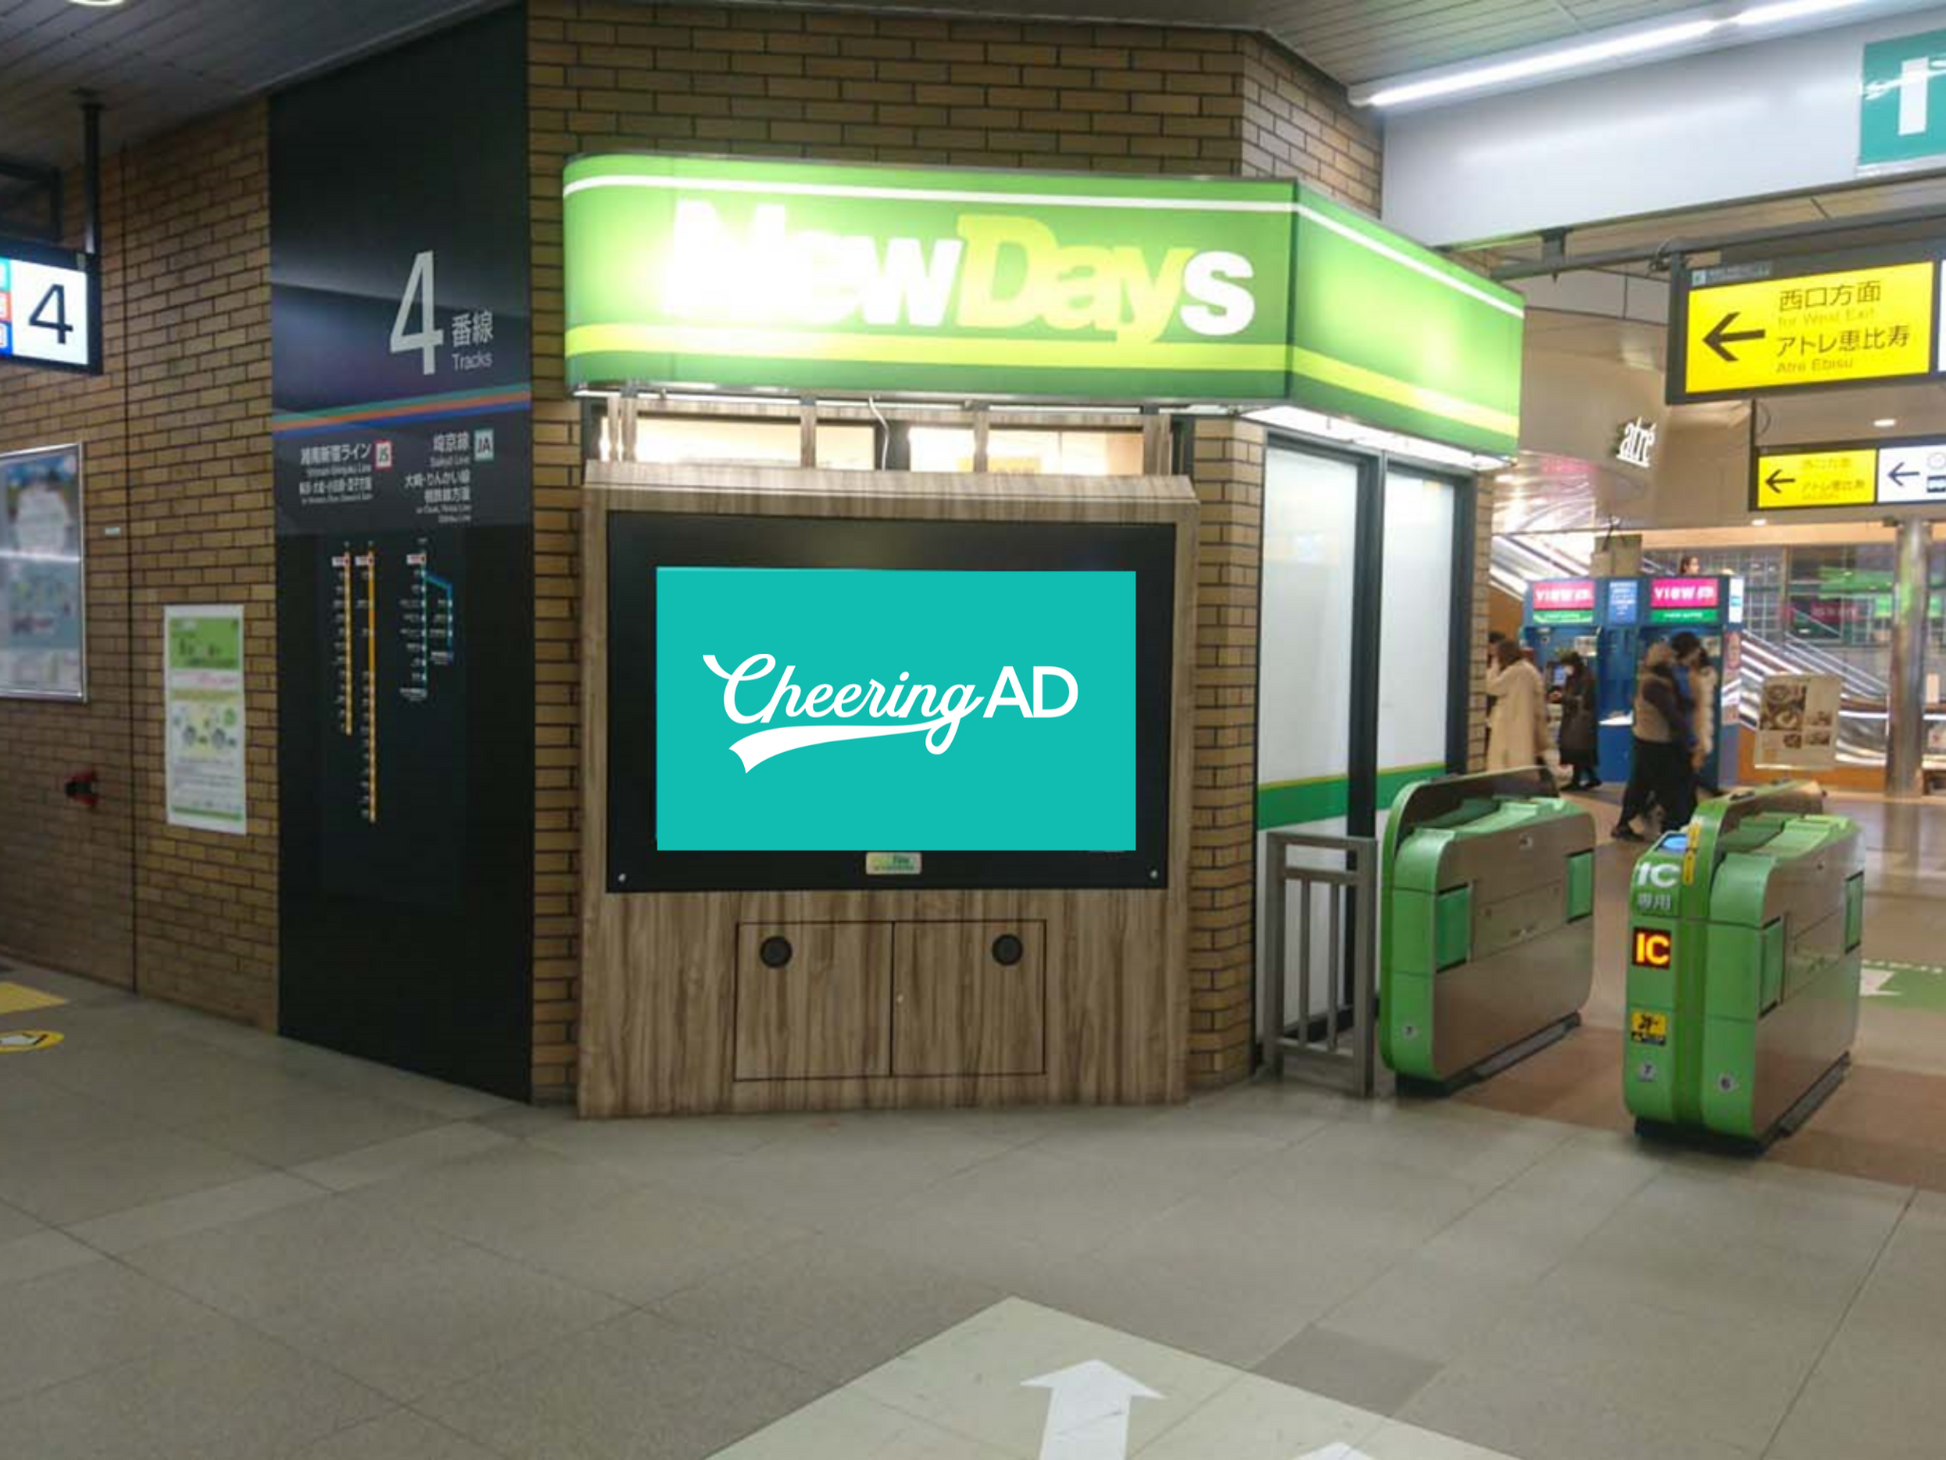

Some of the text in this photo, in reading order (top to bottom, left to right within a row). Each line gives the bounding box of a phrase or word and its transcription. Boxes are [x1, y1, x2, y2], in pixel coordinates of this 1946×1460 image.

[665, 200, 1255, 343] NewDays
[390, 249, 494, 376] 4 番線
[1779, 280, 1881, 313] 西口方面
[28, 283, 74, 346] 4
[1776, 324, 1910, 358] アトレ恵比寿
[451, 351, 493, 372] Tracks
[983, 666, 1079, 718] AD
[1637, 862, 1681, 888] IC
[1637, 932, 1669, 964] IC
